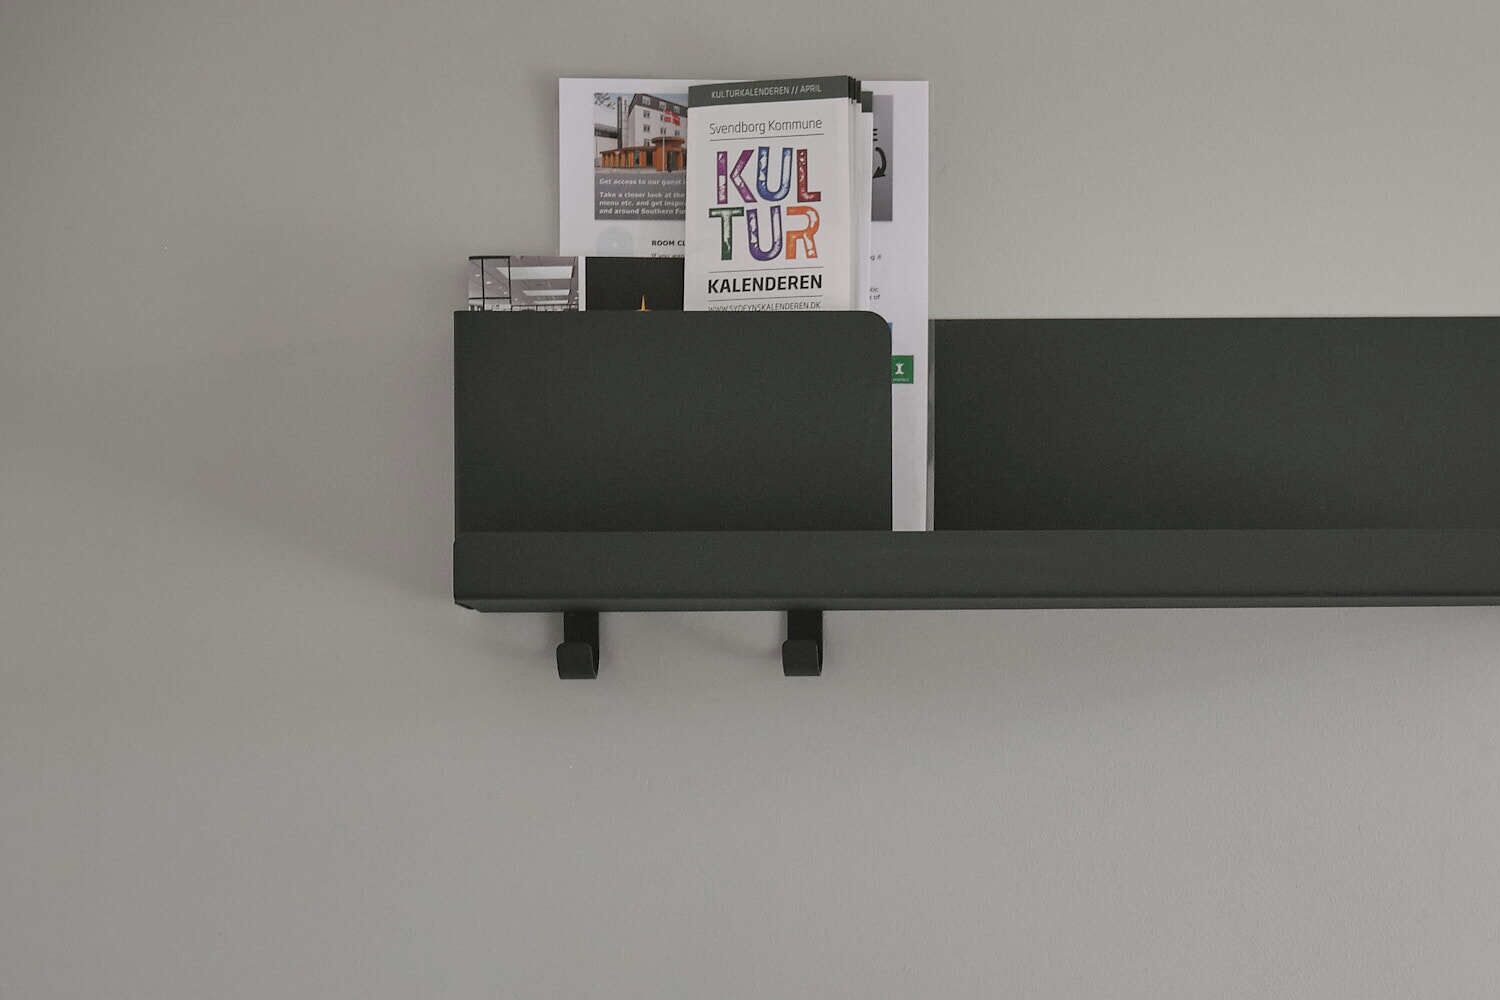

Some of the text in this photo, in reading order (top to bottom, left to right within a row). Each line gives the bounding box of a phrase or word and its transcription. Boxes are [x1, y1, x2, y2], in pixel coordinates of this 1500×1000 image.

[711, 86, 790, 99] KULTURKALENDEREN
[800, 84, 822, 93] APRIL
[709, 119, 823, 135] Svendborg Kommune
[716, 146, 822, 204] KUL
[708, 205, 820, 261] TUR
[708, 274, 822, 294] KALENDEREN
[707, 302, 821, 312] WWWSYDFYNSKALENDEREN.DK
